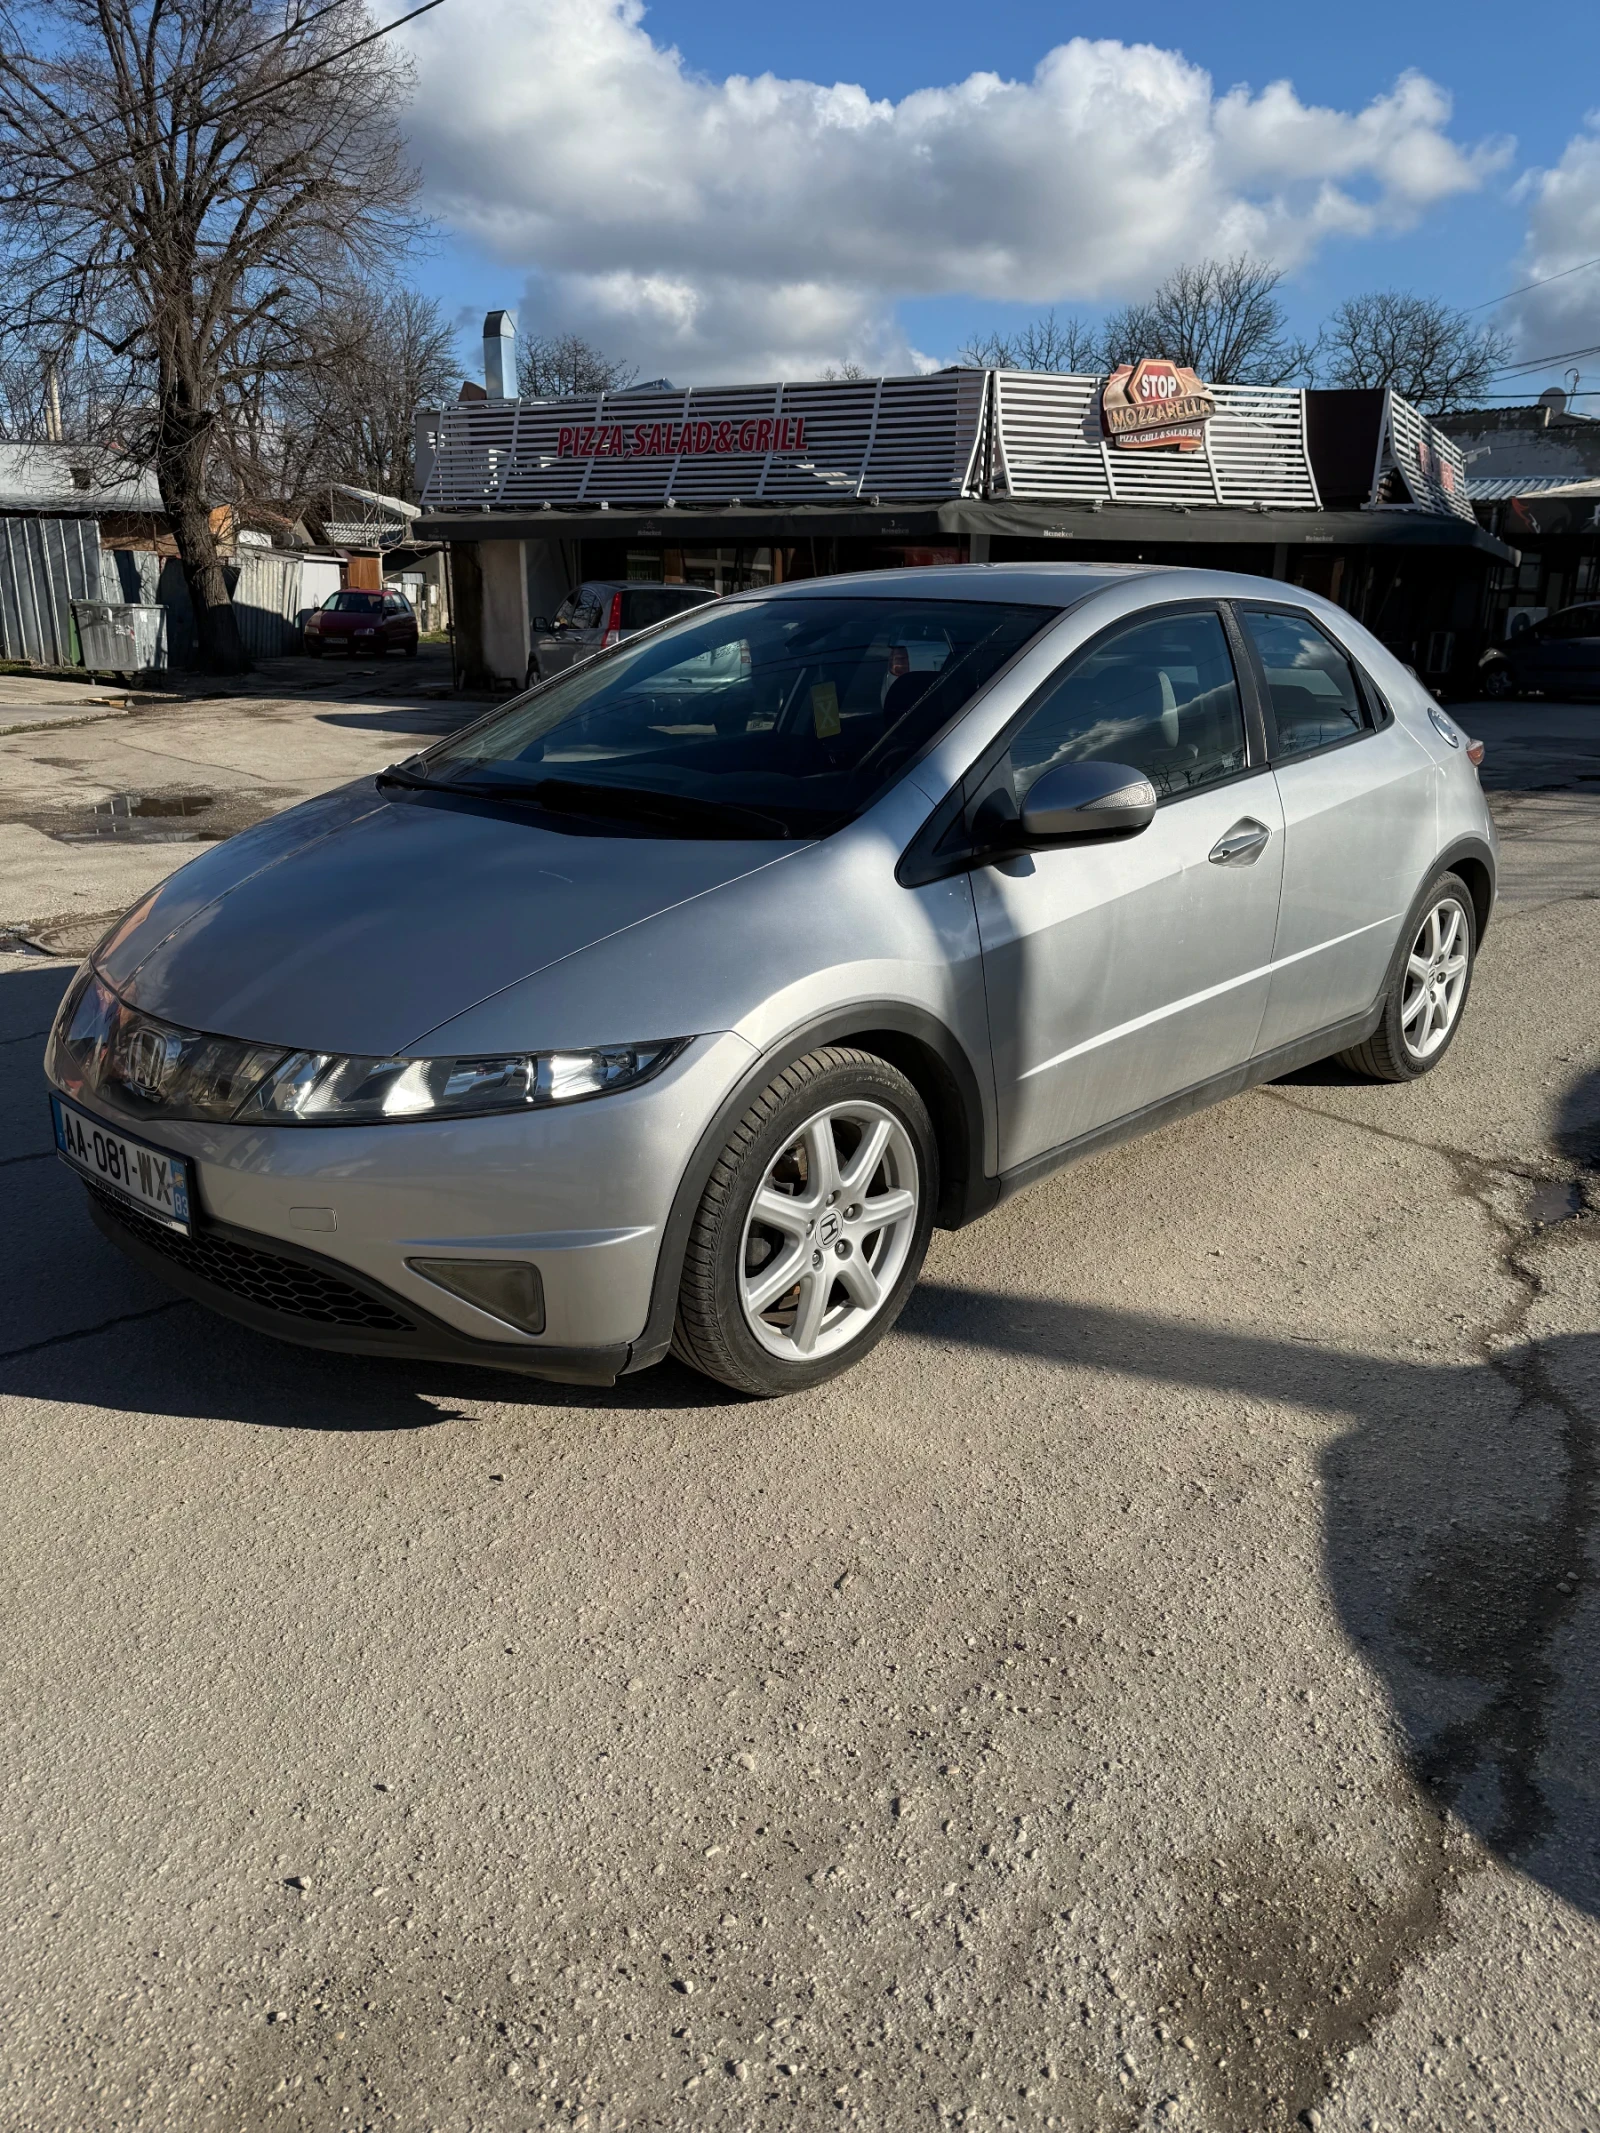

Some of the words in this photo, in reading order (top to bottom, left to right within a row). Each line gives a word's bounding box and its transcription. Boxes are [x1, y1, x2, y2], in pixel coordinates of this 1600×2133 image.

[1141, 374, 1177, 398] STOP
[1112, 399, 1211, 429] MOZZARELLA
[1119, 434, 1140, 444] PIZZA,
[1140, 432, 1160, 442] GRILL
[1159, 431, 1166, 439] &
[1165, 429, 1187, 438] SALAD
[1187, 428, 1202, 437] BAR
[65, 1113, 172, 1206] AA-081-WX
[174, 1193, 189, 1217] 83
